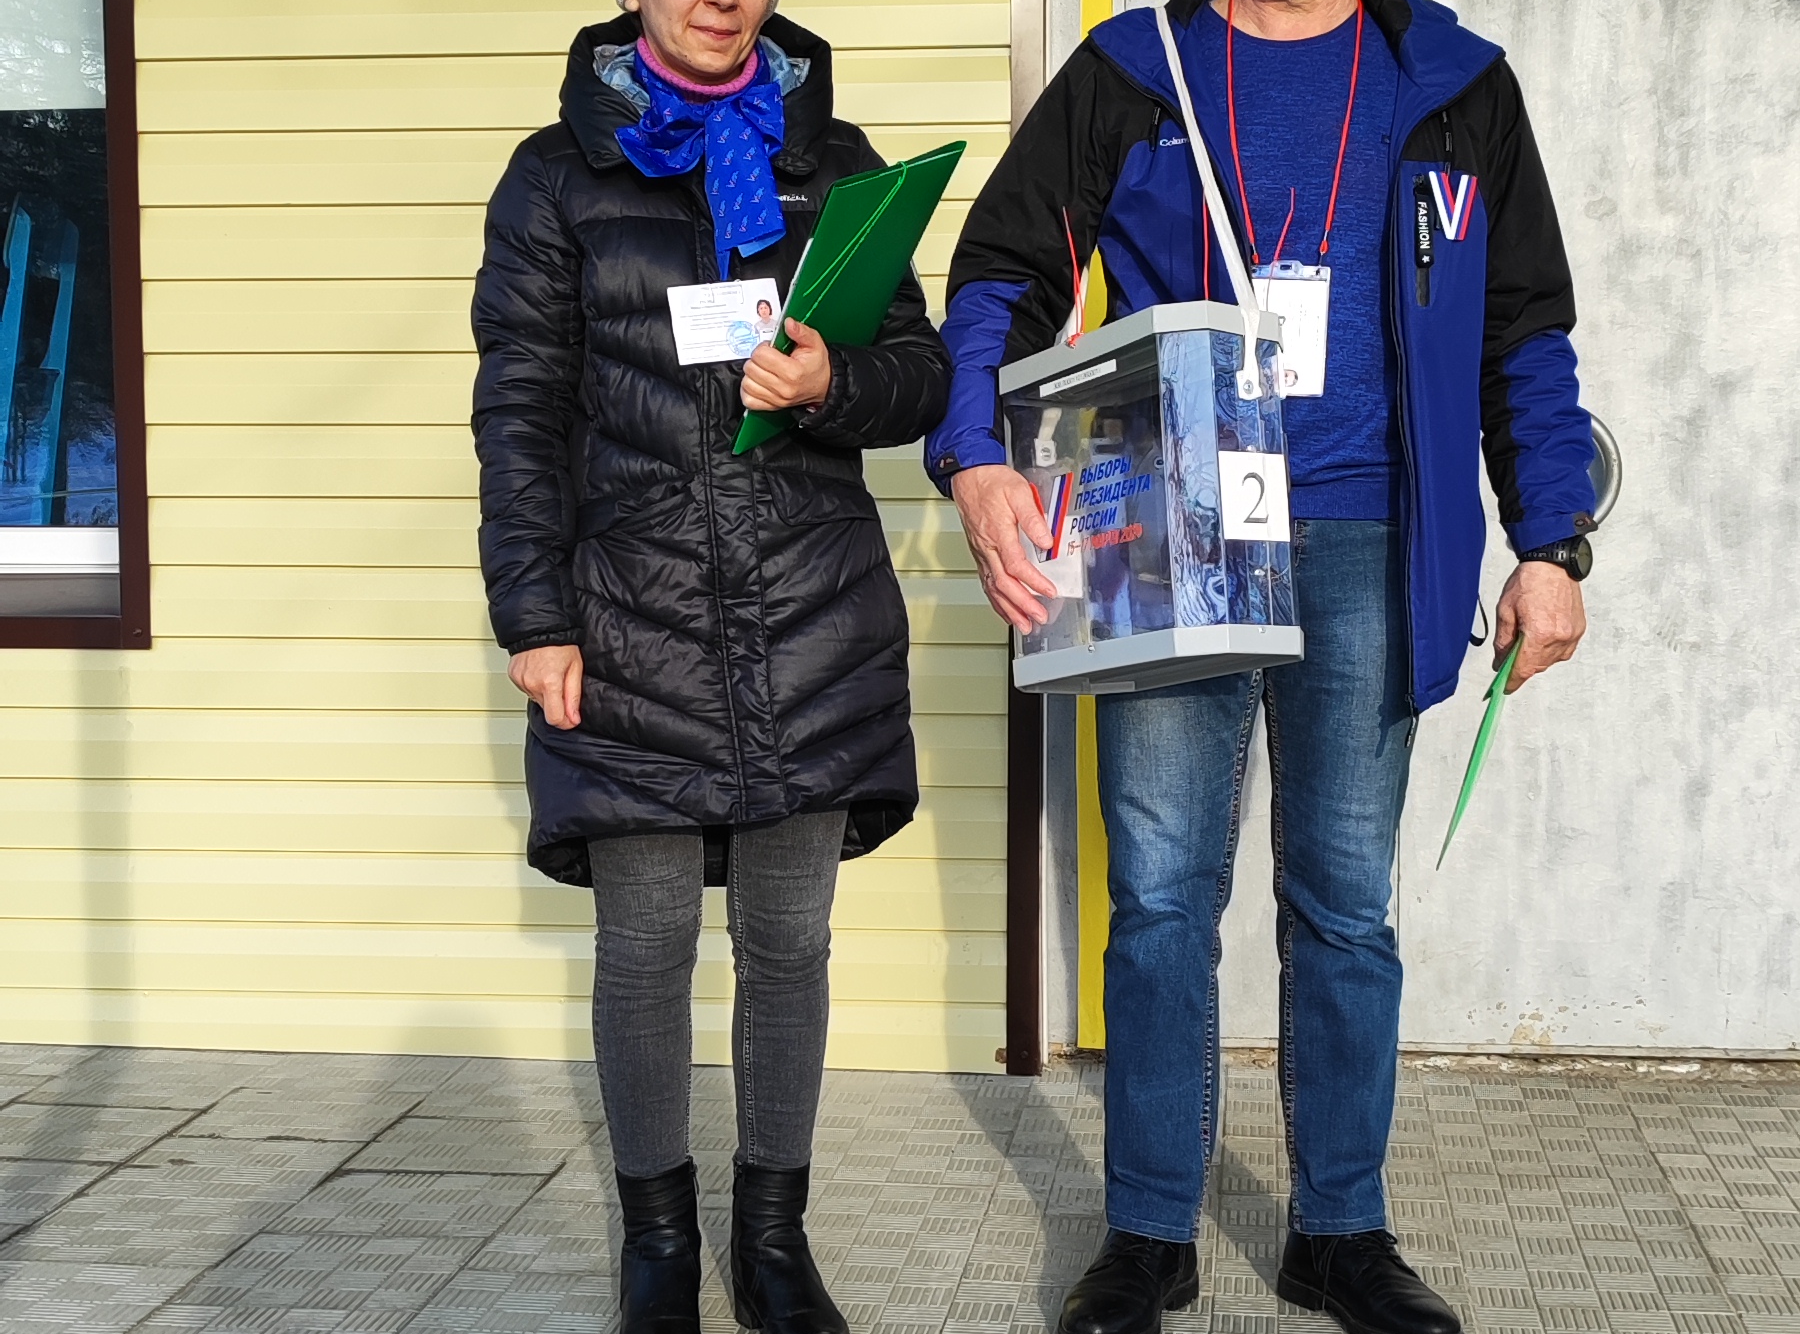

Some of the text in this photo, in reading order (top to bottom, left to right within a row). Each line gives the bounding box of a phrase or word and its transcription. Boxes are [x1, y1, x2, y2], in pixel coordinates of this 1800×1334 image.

[1417, 201, 1431, 250] FASHION
[1079, 454, 1132, 486] ВЫБОРЫ
[1074, 473, 1152, 511] ПРЕЗИДЕНТА
[1241, 472, 1270, 524] 2
[1069, 506, 1118, 535] РОССИИ
